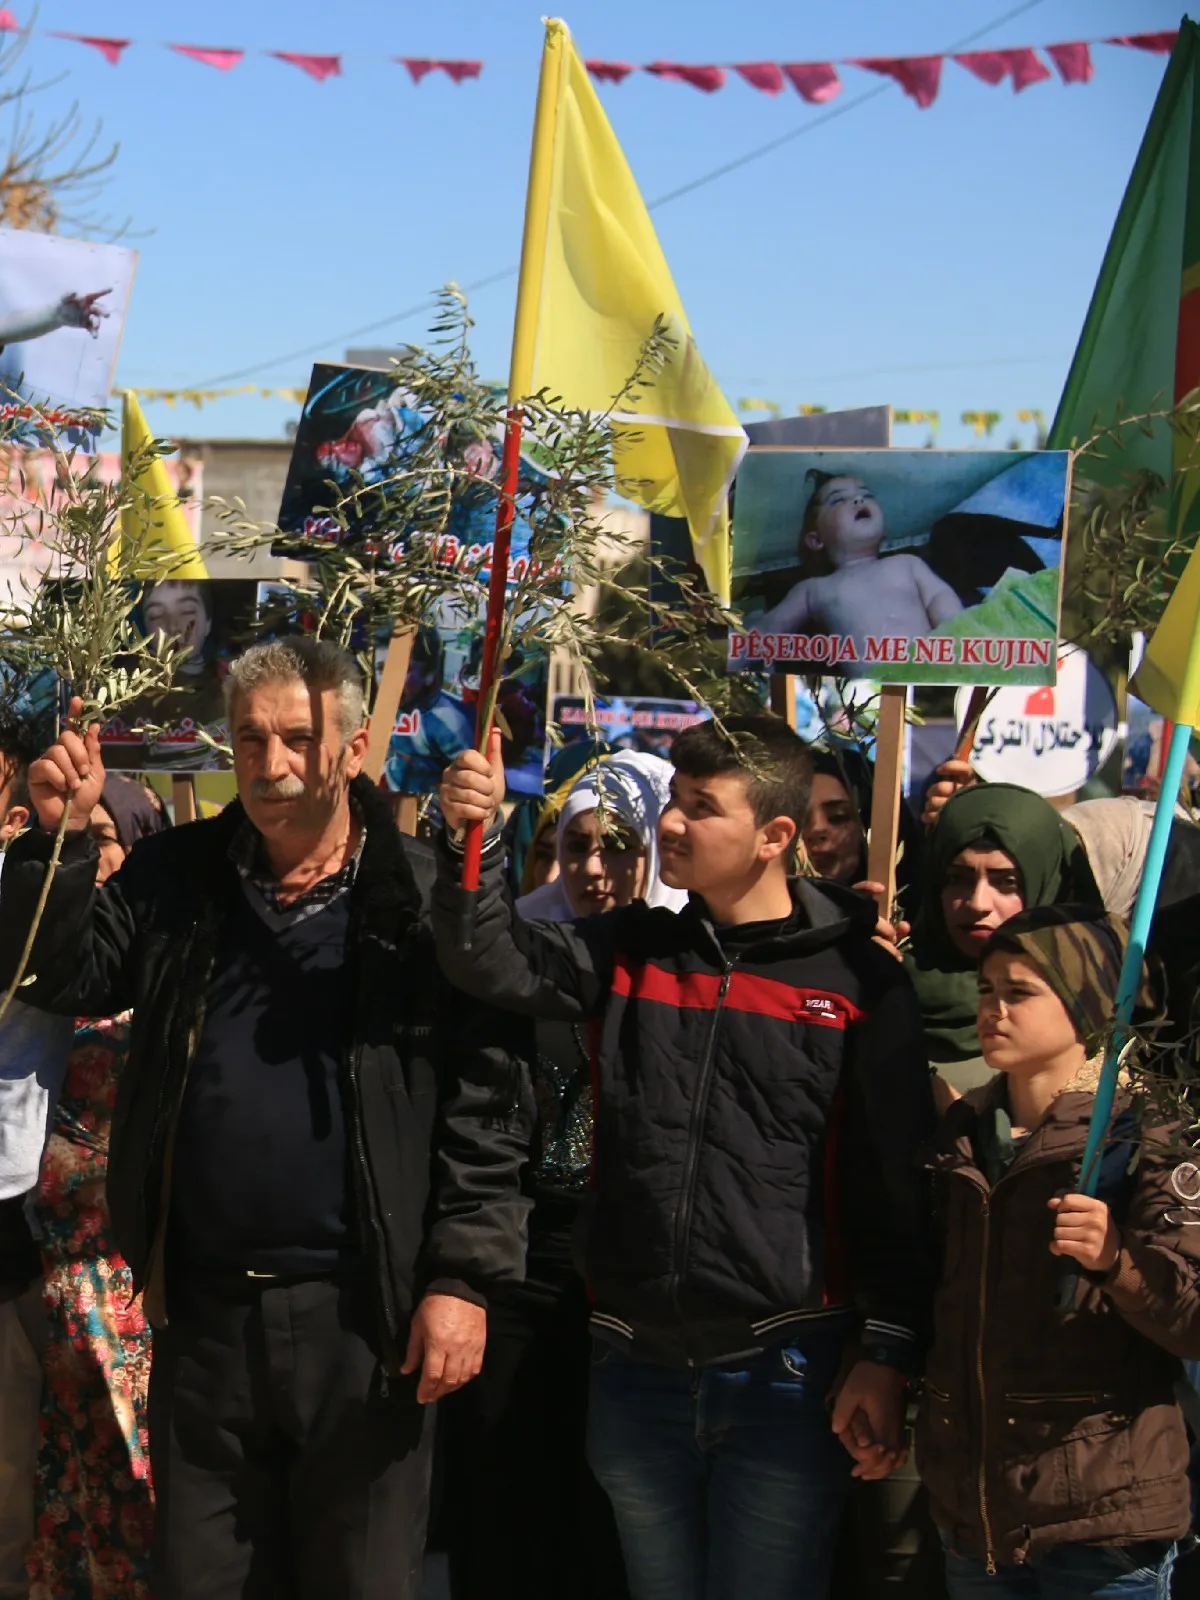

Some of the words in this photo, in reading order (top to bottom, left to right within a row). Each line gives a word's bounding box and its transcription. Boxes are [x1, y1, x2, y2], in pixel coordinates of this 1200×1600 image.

[729, 629, 858, 667] PÊŞEROJA
[865, 634, 908, 663] ME
[914, 636, 955, 664] NE
[960, 637, 1053, 670] KUJIN
[973, 717, 1030, 761] التركي
